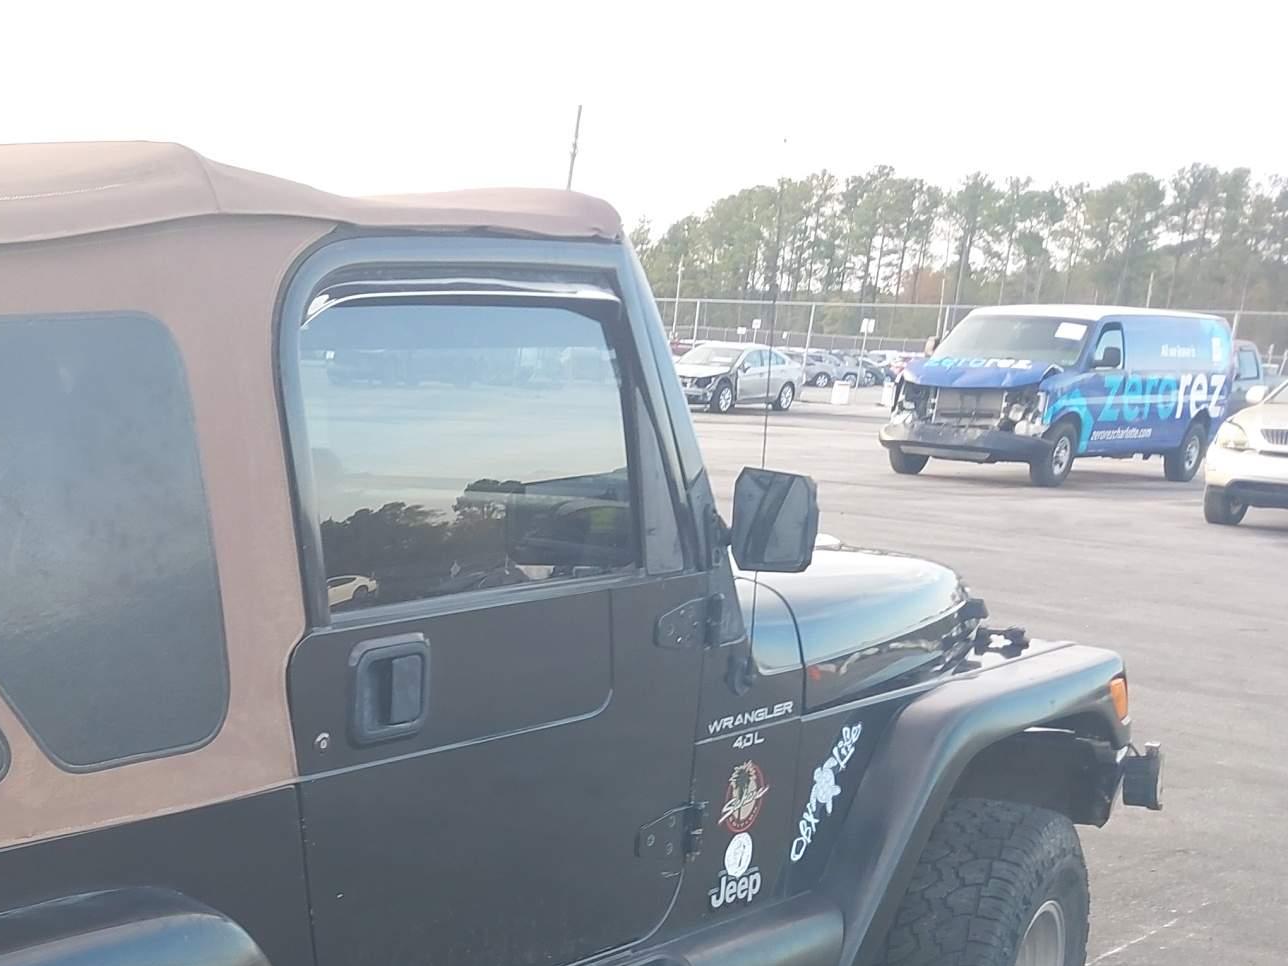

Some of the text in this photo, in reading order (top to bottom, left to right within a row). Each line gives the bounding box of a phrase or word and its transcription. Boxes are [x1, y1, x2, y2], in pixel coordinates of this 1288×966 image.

[1097, 372, 1226, 422] zerorez
[708, 701, 793, 734] WRANGLER
[711, 872, 761, 908] Jeep
